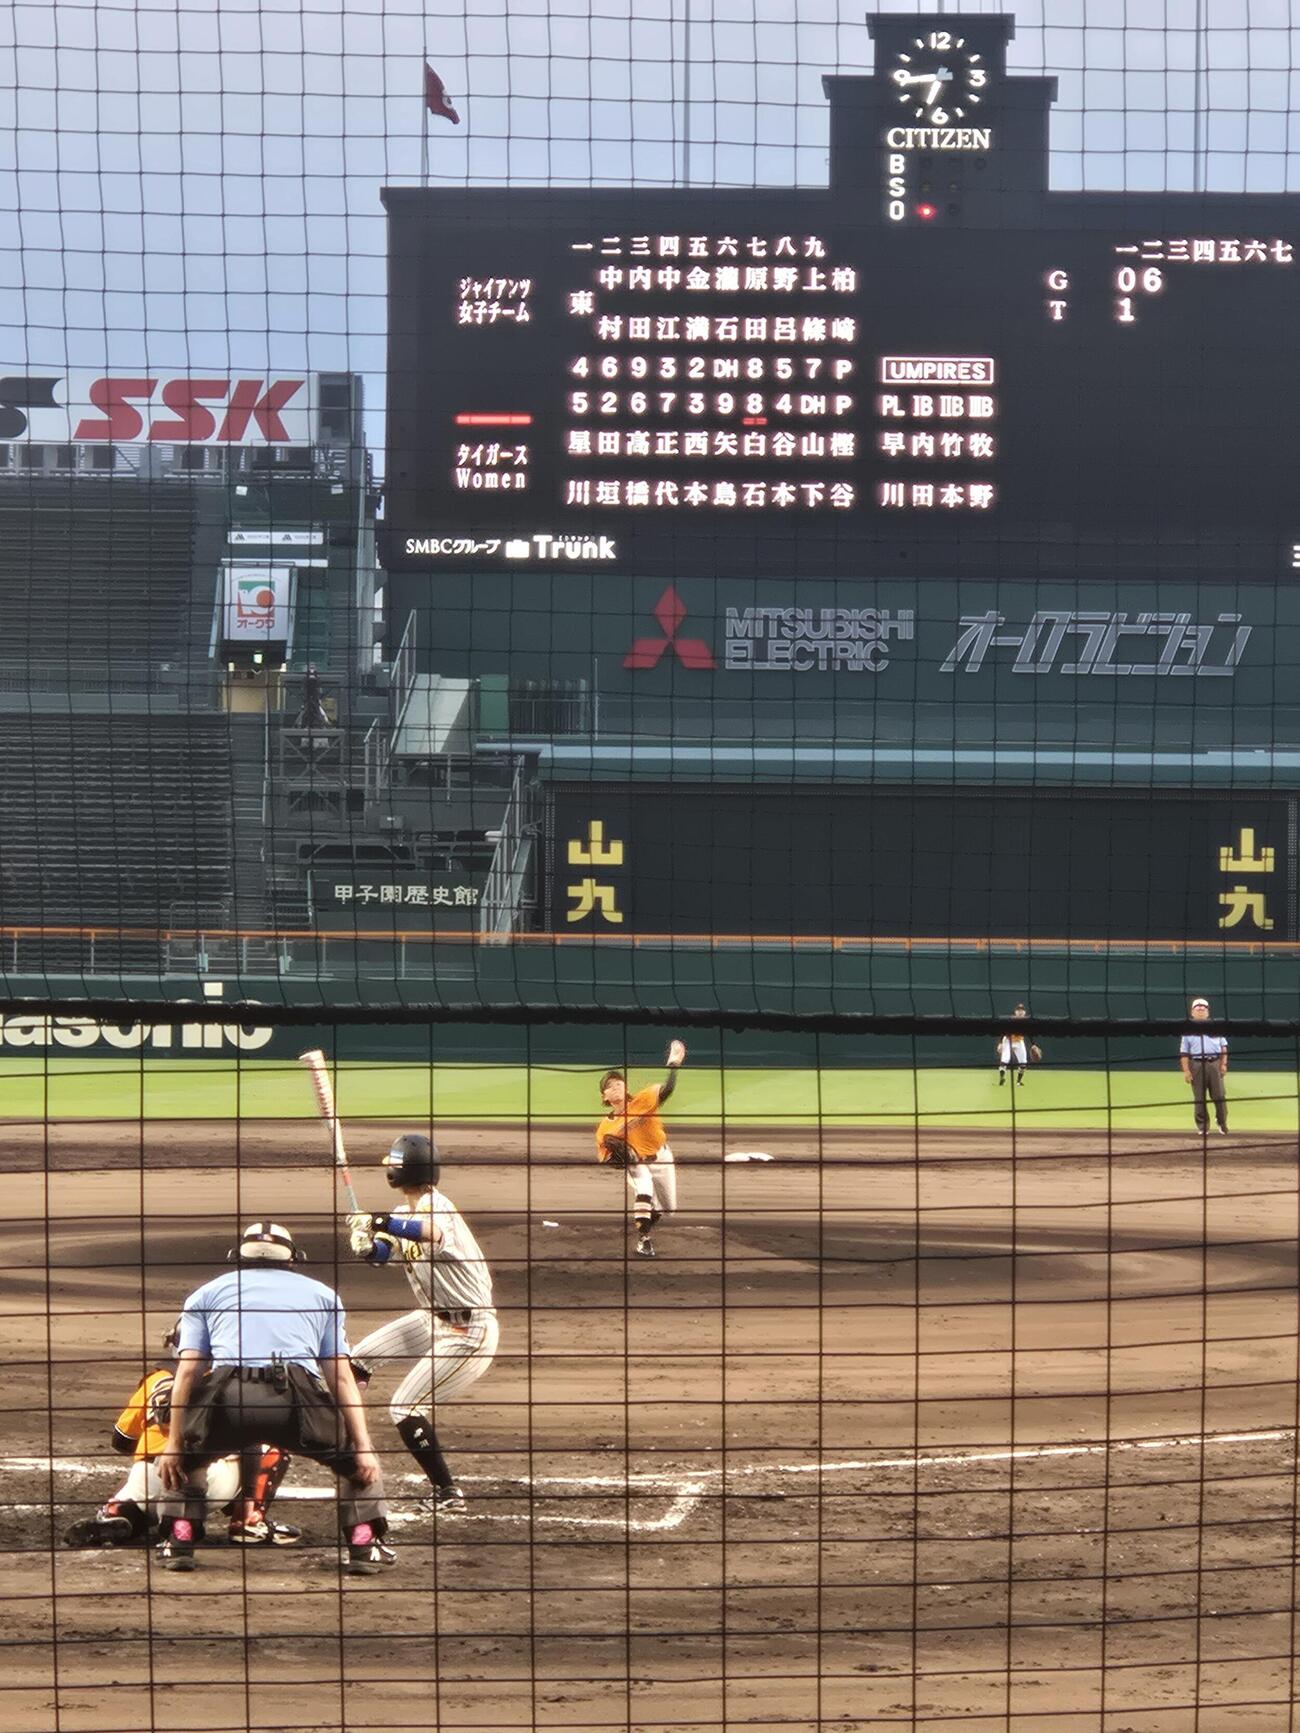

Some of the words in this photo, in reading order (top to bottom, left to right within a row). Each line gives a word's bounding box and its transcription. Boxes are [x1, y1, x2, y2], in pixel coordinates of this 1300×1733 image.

[930, 31, 952, 50] 12
[968, 69, 987, 87] 3
[930, 106, 949, 125] 6
[886, 127, 992, 150] CITIZEN
[889, 153, 905, 175] B
[888, 176, 906, 198] S
[459, 276, 531, 300] ジャイアンツ
[1048, 270, 1069, 290] G
[458, 300, 530, 325] 女子チーム
[1049, 300, 1067, 321] T
[1118, 297, 1135, 322] 1
[890, 361, 987, 380] UMPIRES
[73, 377, 305, 442] SSK
[457, 442, 528, 466] タイガース
[455, 467, 526, 489] Women
[405, 538, 502, 555] SMBCグループ
[532, 534, 616, 560] Trunk
[236, 619, 275, 629] オークワ
[725, 607, 914, 640] MITSUBISHI
[939, 610, 1253, 676] オーロラビジョン
[725, 640, 889, 672] ELECTRIC
[567, 820, 623, 923] 山九
[1218, 828, 1274, 930] 山九
[334, 884, 479, 905] 甲子園歴史館
